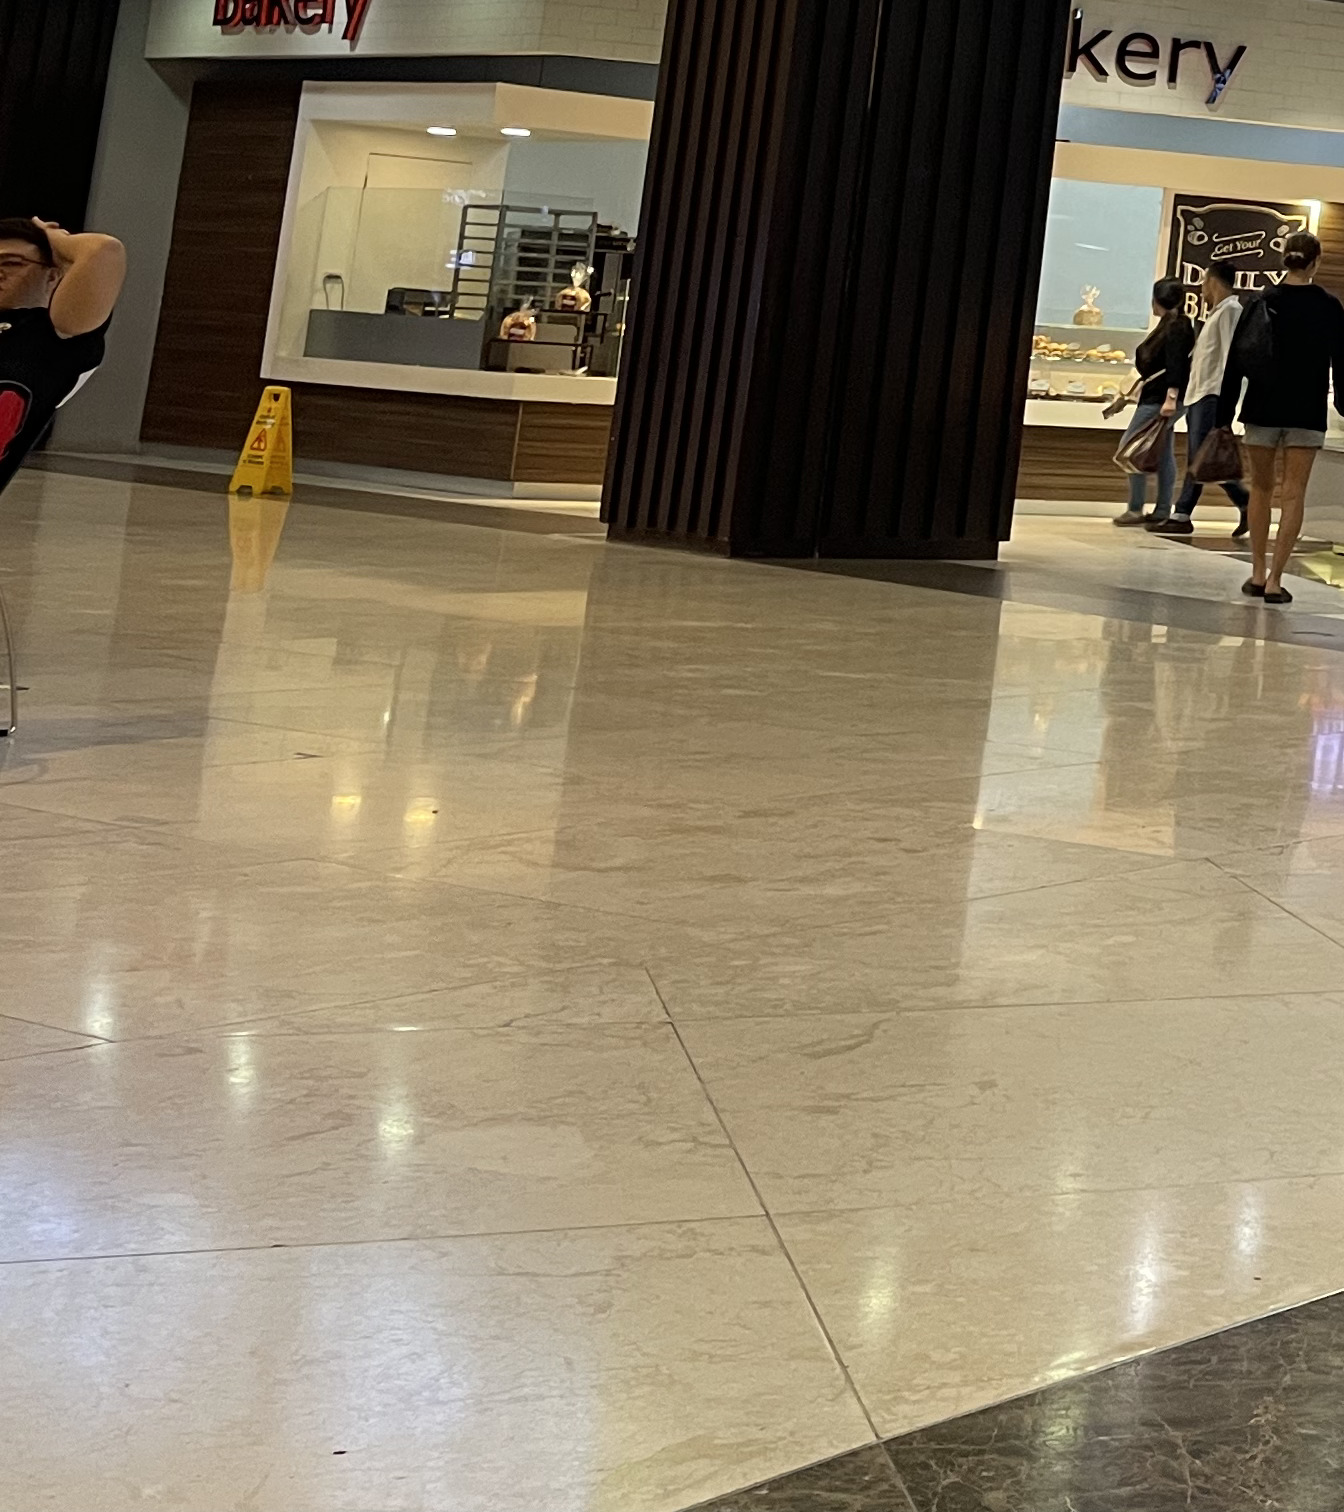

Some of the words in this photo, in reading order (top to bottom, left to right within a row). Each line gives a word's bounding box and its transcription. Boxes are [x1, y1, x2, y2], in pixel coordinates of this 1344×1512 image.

[1214, 242, 1233, 254] Get
[1236, 238, 1261, 251] Your
[1182, 261, 1289, 290] DILY
